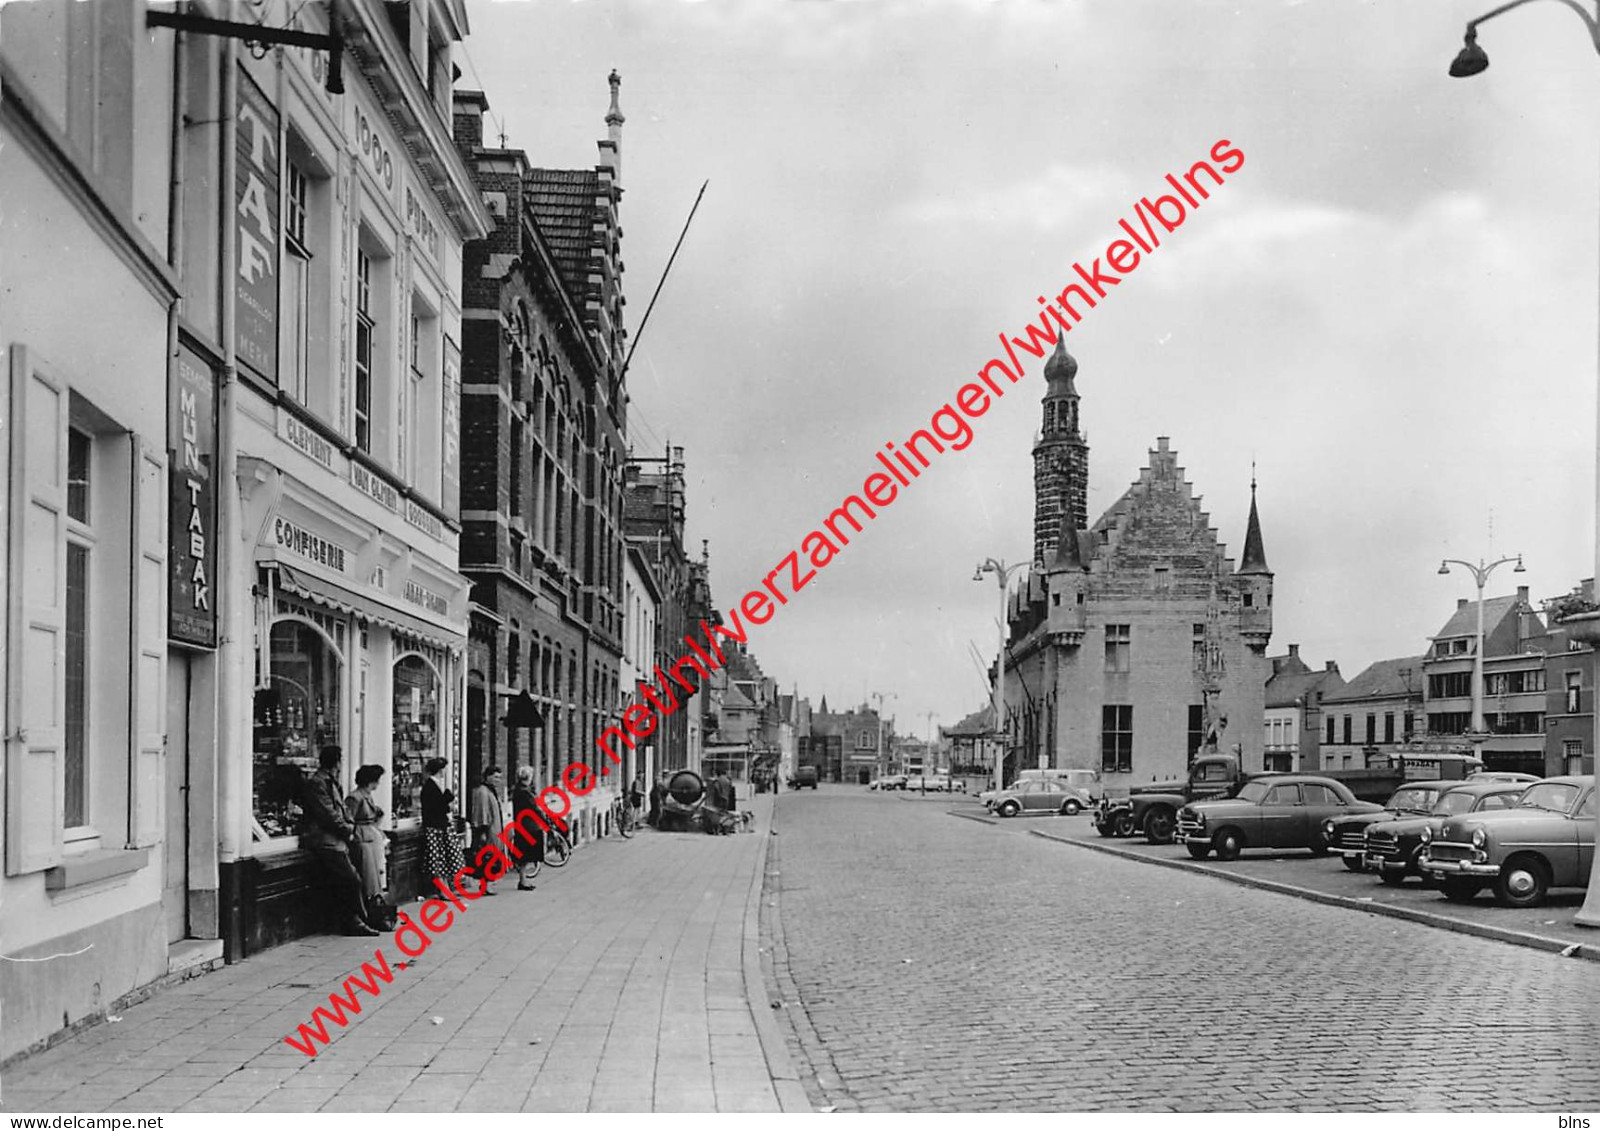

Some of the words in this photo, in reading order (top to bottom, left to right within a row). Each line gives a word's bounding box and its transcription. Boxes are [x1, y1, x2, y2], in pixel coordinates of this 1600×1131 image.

[354, 104, 393, 191] 1000
[237, 103, 275, 285] TAF
[286, 418, 332, 467] CLEMENT
[353, 464, 369, 493] VAN
[187, 478, 209, 611] TABAK
[275, 518, 345, 572] CONFISERIE
